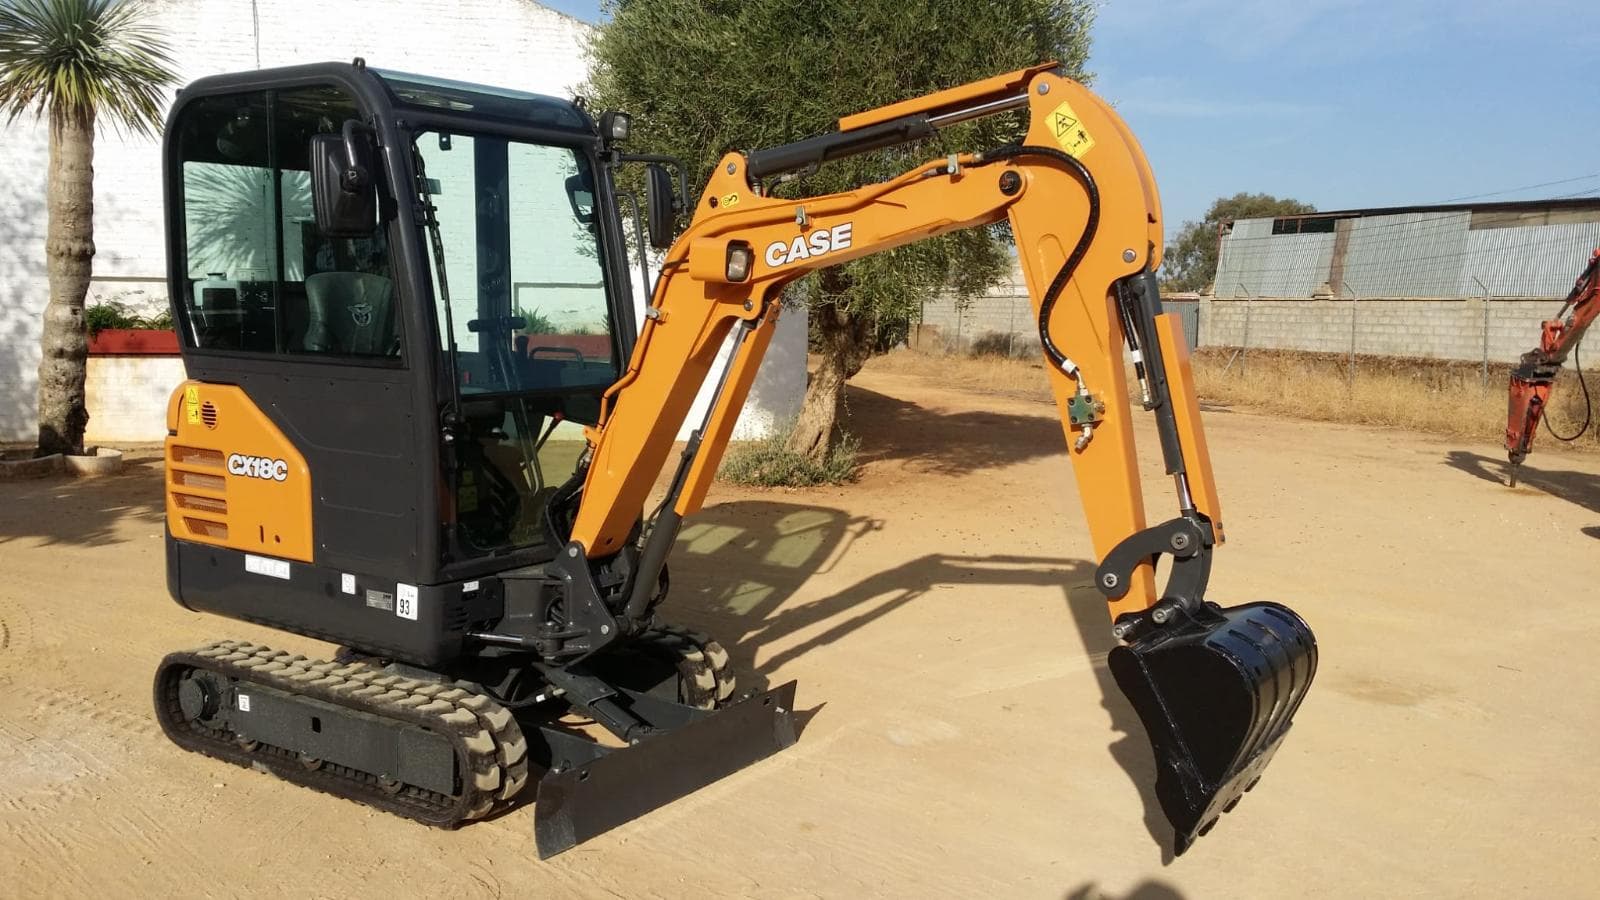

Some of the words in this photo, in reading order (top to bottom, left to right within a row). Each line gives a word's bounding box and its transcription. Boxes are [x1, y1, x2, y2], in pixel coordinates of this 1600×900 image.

[765, 222, 853, 267] CASE
[228, 453, 288, 482] CX18C
[400, 598, 410, 615] 93
